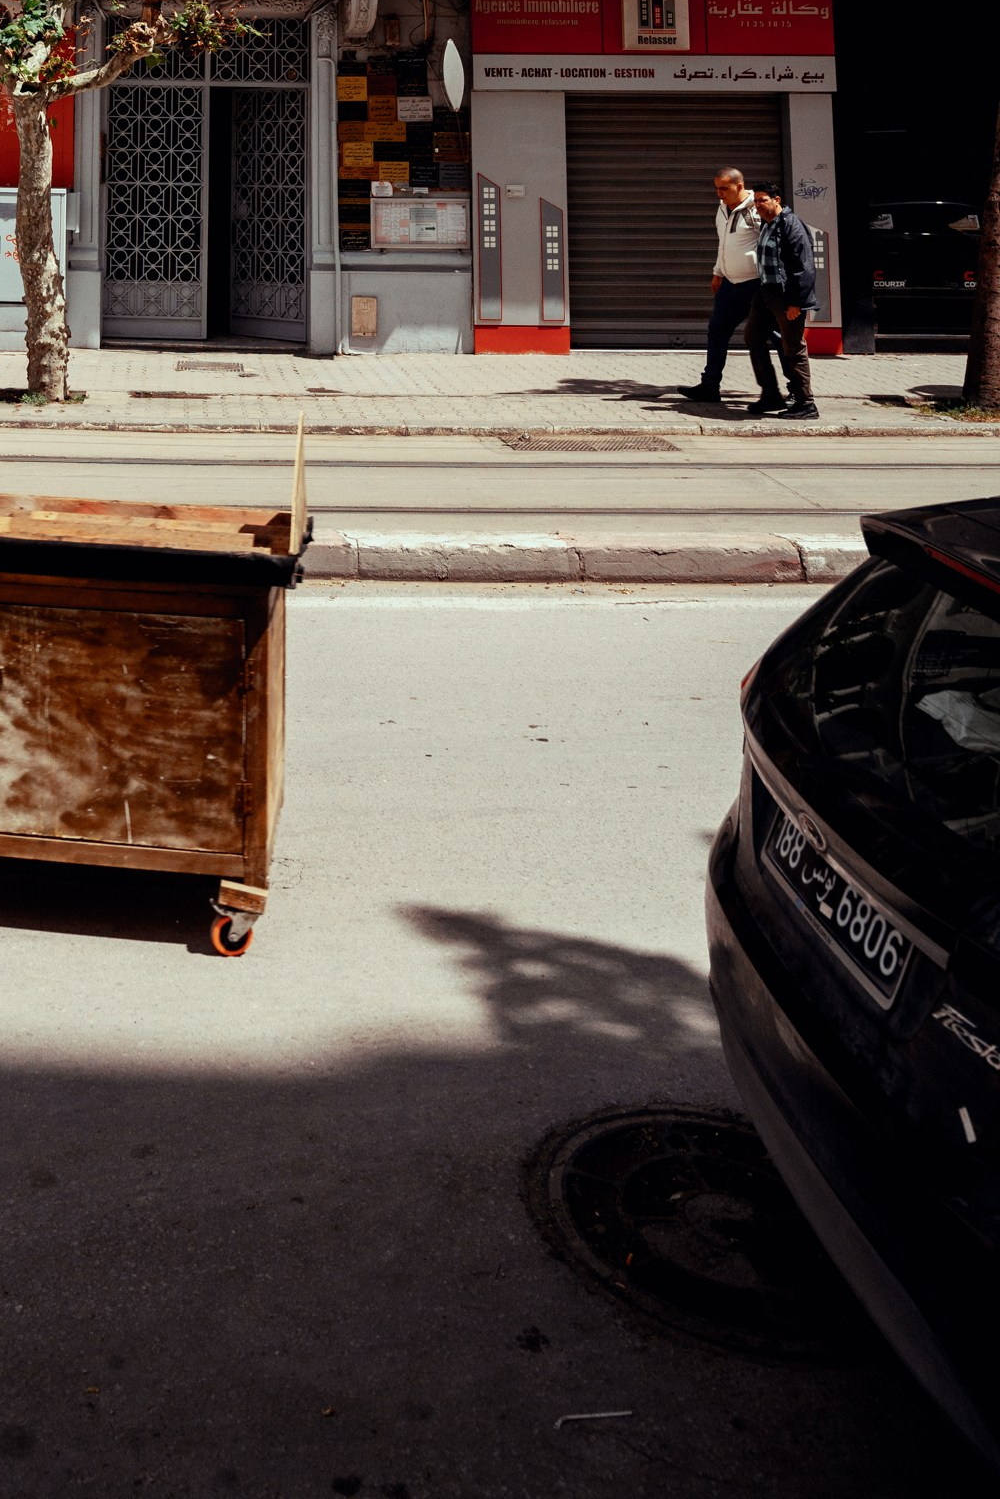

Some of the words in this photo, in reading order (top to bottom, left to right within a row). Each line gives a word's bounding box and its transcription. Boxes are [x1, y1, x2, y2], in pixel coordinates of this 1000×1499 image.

[708, 0, 763, 18] عقارية
[771, 1, 829, 19] وكالة
[637, 35, 677, 45] Relasser
[484, 67, 513, 78] VENTE
[521, 67, 552, 78] ACHAT
[560, 68, 606, 78] LOCATION
[615, 68, 655, 79] GESTION
[775, 813, 806, 868] 188
[836, 885, 903, 976] 6806
